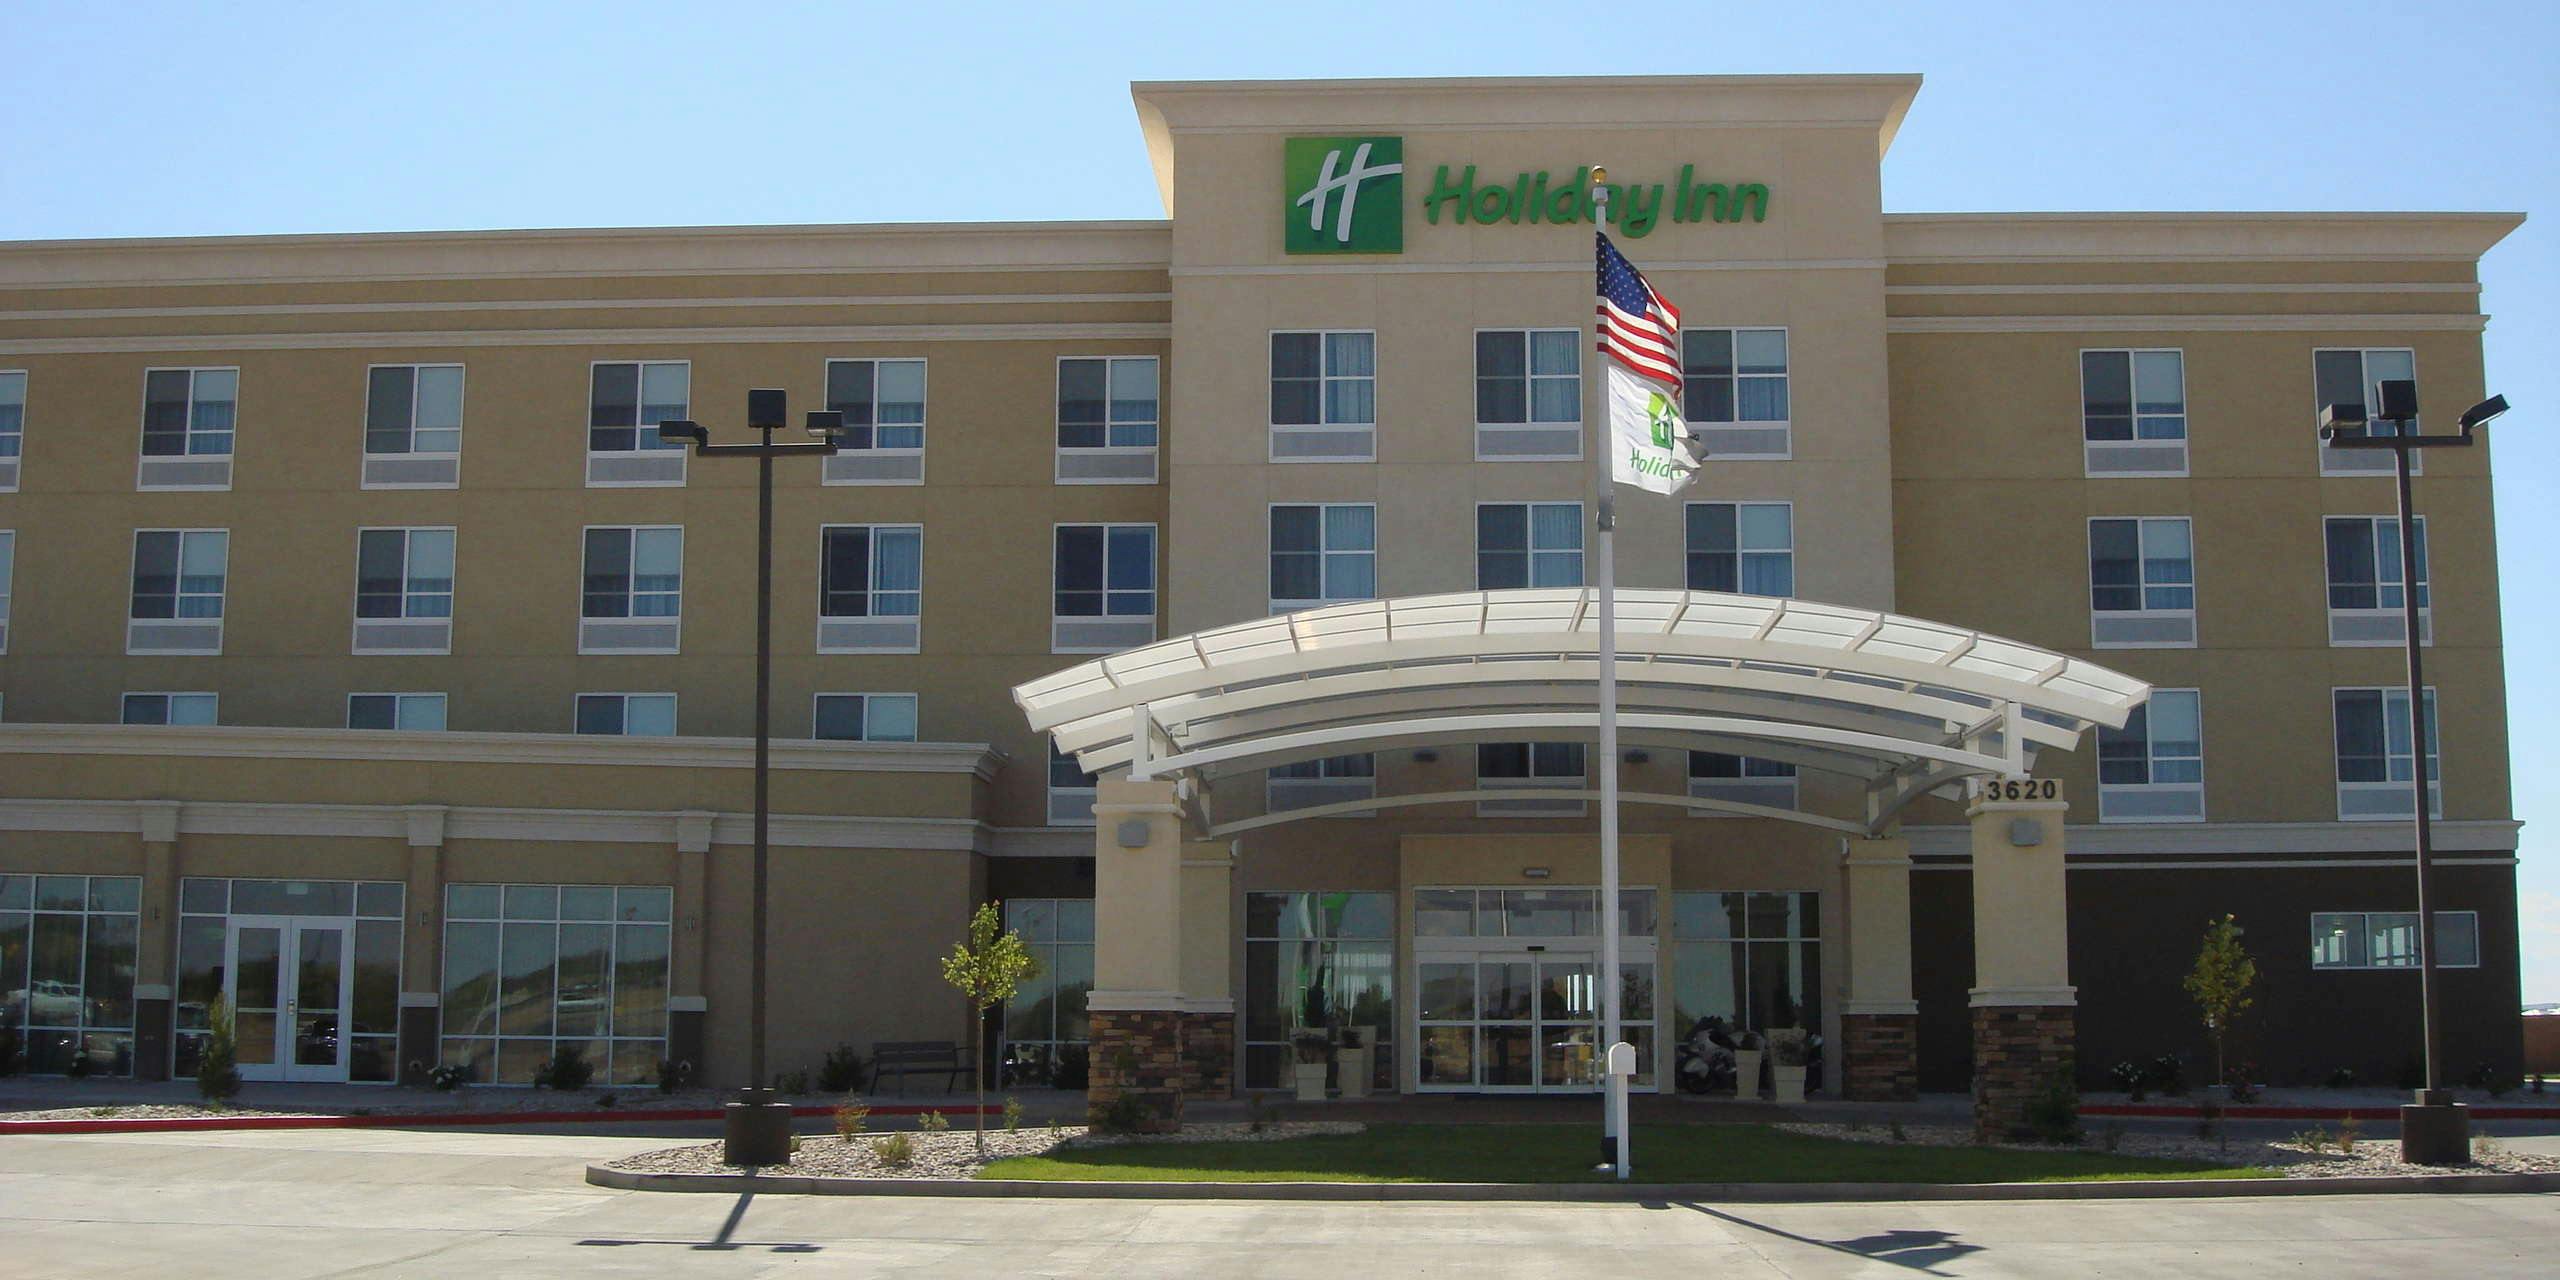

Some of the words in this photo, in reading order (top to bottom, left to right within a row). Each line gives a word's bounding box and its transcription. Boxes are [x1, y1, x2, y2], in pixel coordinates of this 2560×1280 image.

[1424, 164, 1663, 238] Holiday
[1673, 164, 1769, 223] Inn
[1987, 780, 2056, 801] 3620
